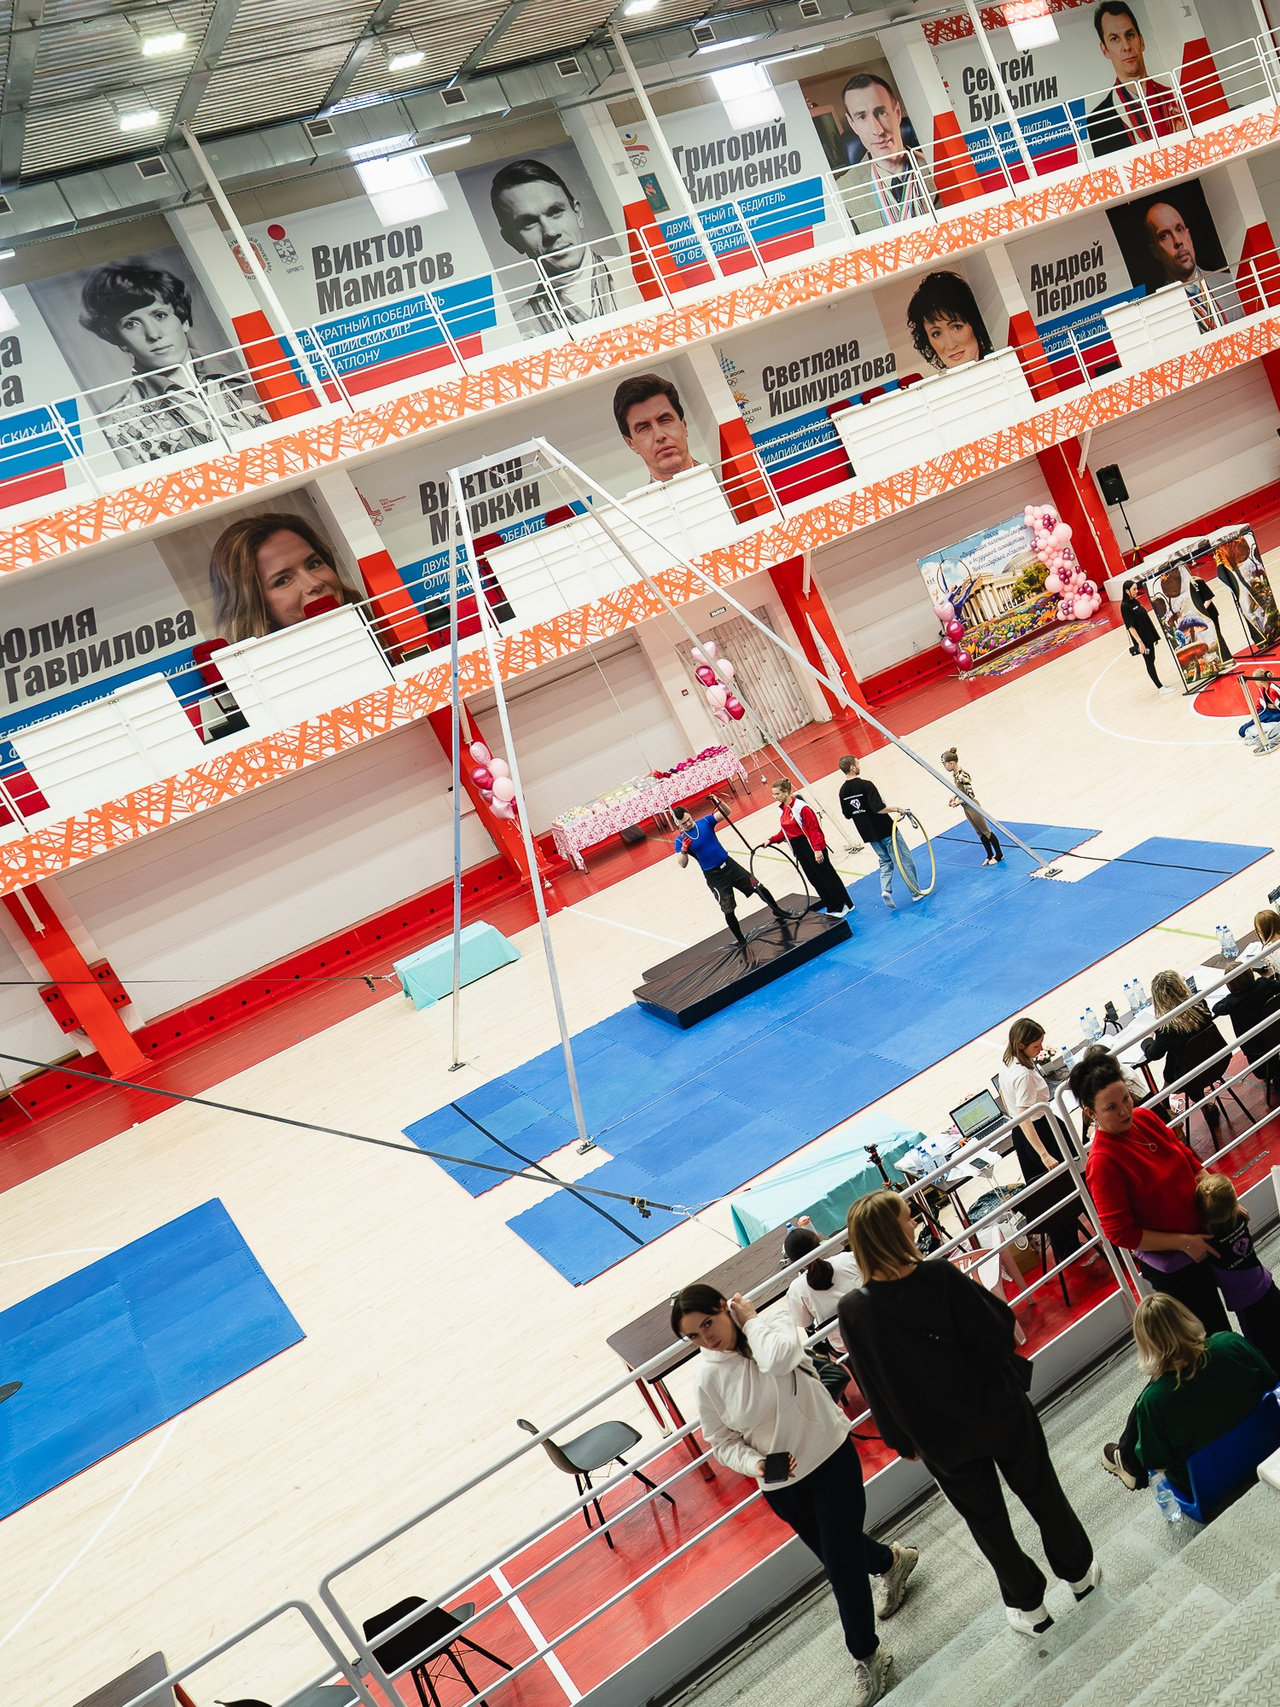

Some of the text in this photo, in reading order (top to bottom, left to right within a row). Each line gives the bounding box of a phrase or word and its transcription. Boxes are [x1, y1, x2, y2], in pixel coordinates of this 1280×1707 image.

[961, 49, 1034, 94] Сергей
[968, 75, 1058, 122] Булыгин
[672, 117, 788, 176] Григорий
[681, 150, 802, 204] Кириенко
[310, 224, 424, 281] Виктор
[1030, 240, 1104, 292] Андрей
[315, 251, 455, 316] Маматов
[1036, 271, 1108, 317] Перлов
[319, 347, 381, 377] БАТЛОНУ
[762, 339, 860, 392] Светлана
[768, 351, 897, 418] Ишмуратова
[0, 606, 98, 669] Юлия
[4, 609, 197, 705] Гаврилова
